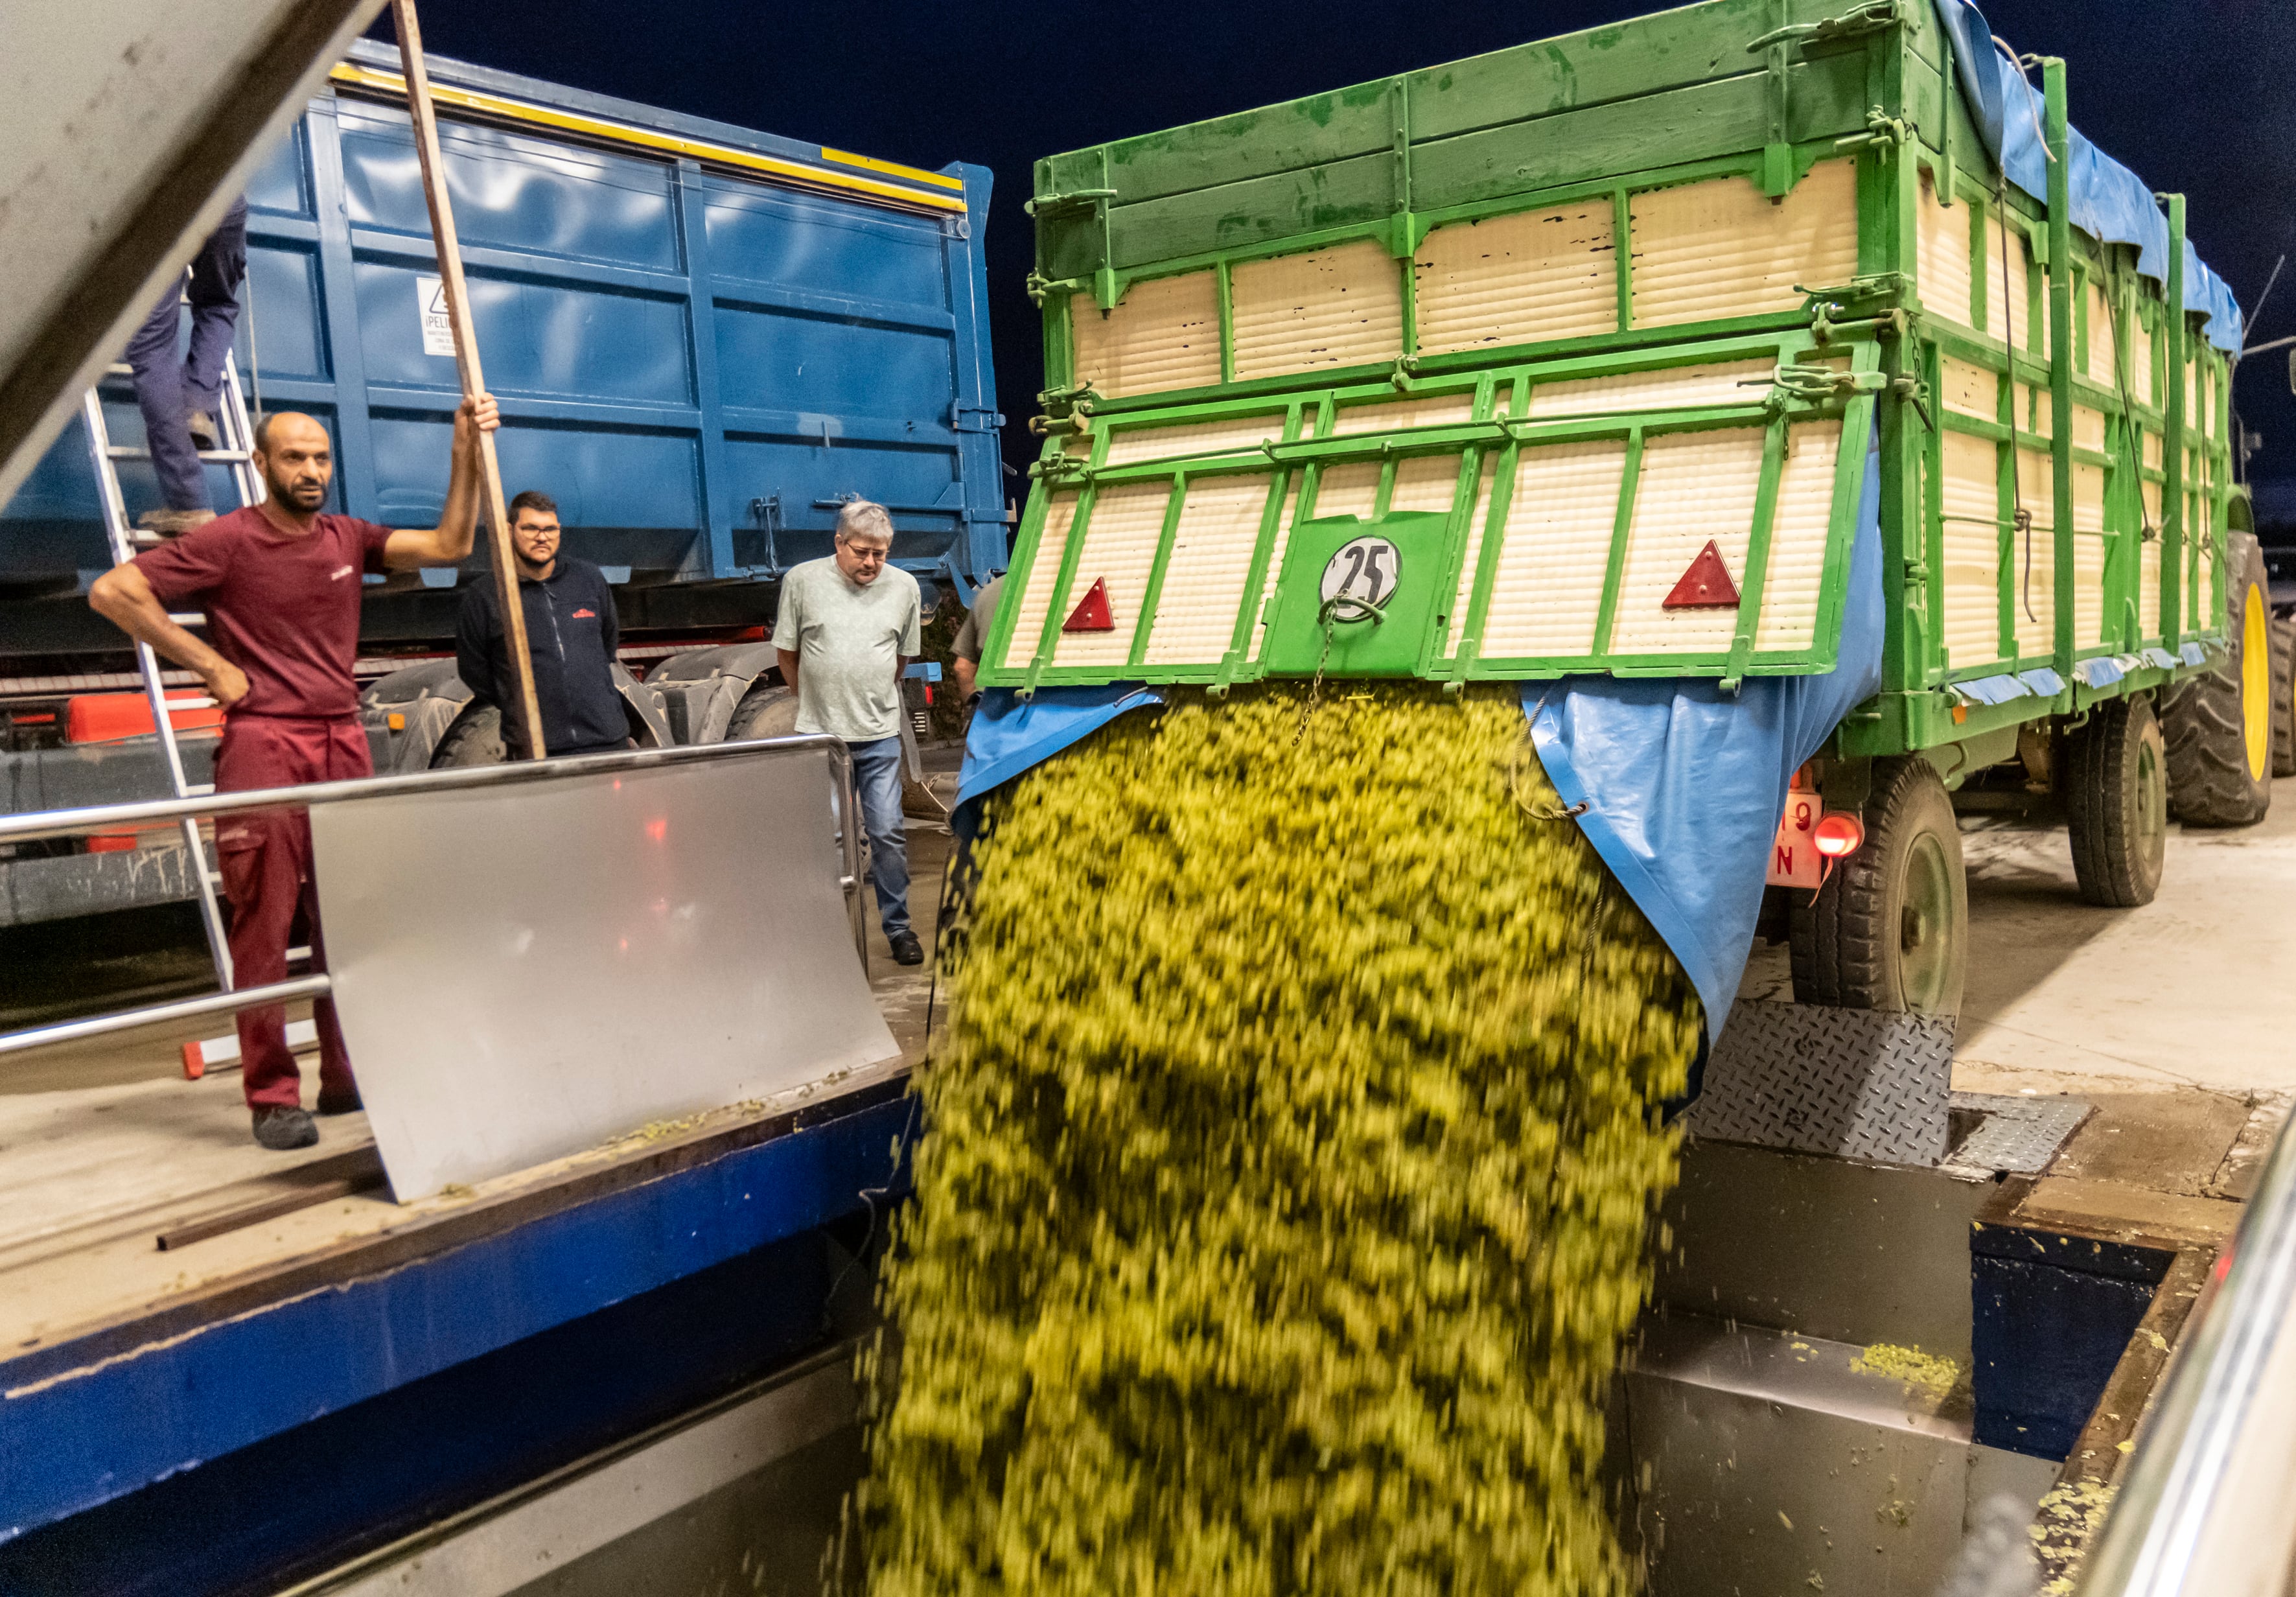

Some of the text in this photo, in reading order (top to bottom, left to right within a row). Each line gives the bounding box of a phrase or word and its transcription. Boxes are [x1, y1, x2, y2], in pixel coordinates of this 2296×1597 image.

[425, 316, 450, 329] ¡PELI
[1333, 545, 1389, 609] 25
[1777, 845, 1792, 875] N
